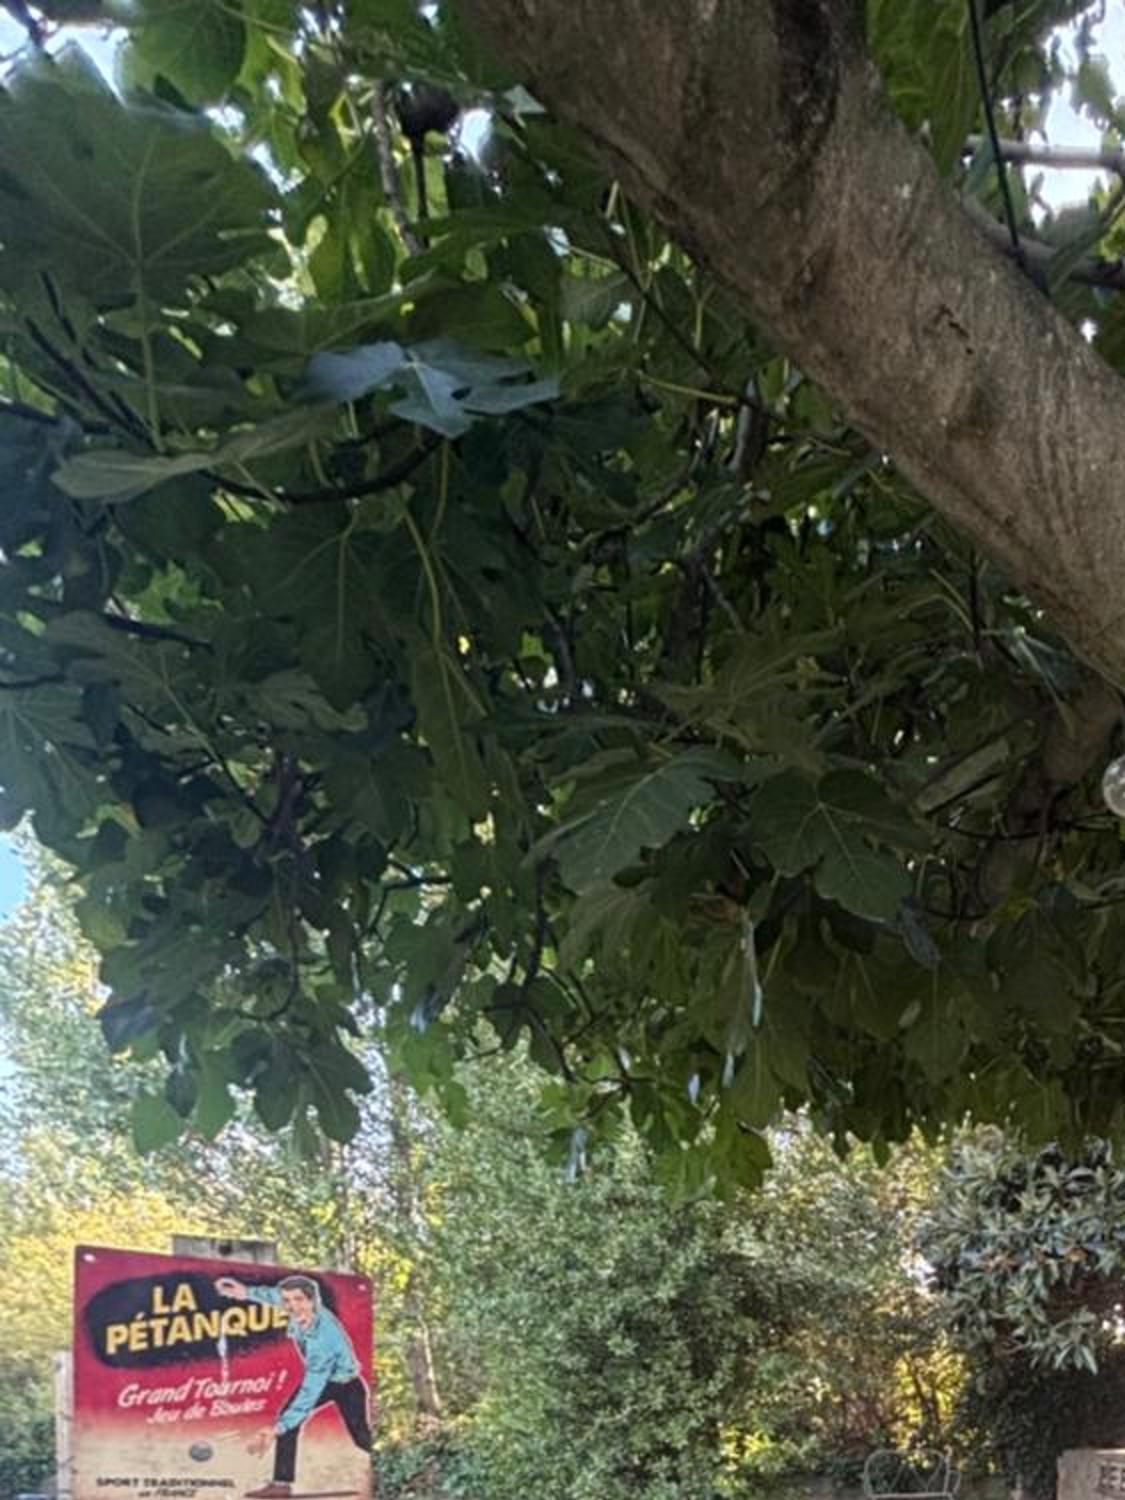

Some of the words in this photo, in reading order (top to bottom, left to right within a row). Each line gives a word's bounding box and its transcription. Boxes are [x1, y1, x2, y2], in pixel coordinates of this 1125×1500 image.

[152, 1283, 197, 1315] LA
[106, 1303, 289, 1355] PÉTANQUE
[117, 1376, 194, 1407] Grand
[183, 1402, 205, 1420] de
